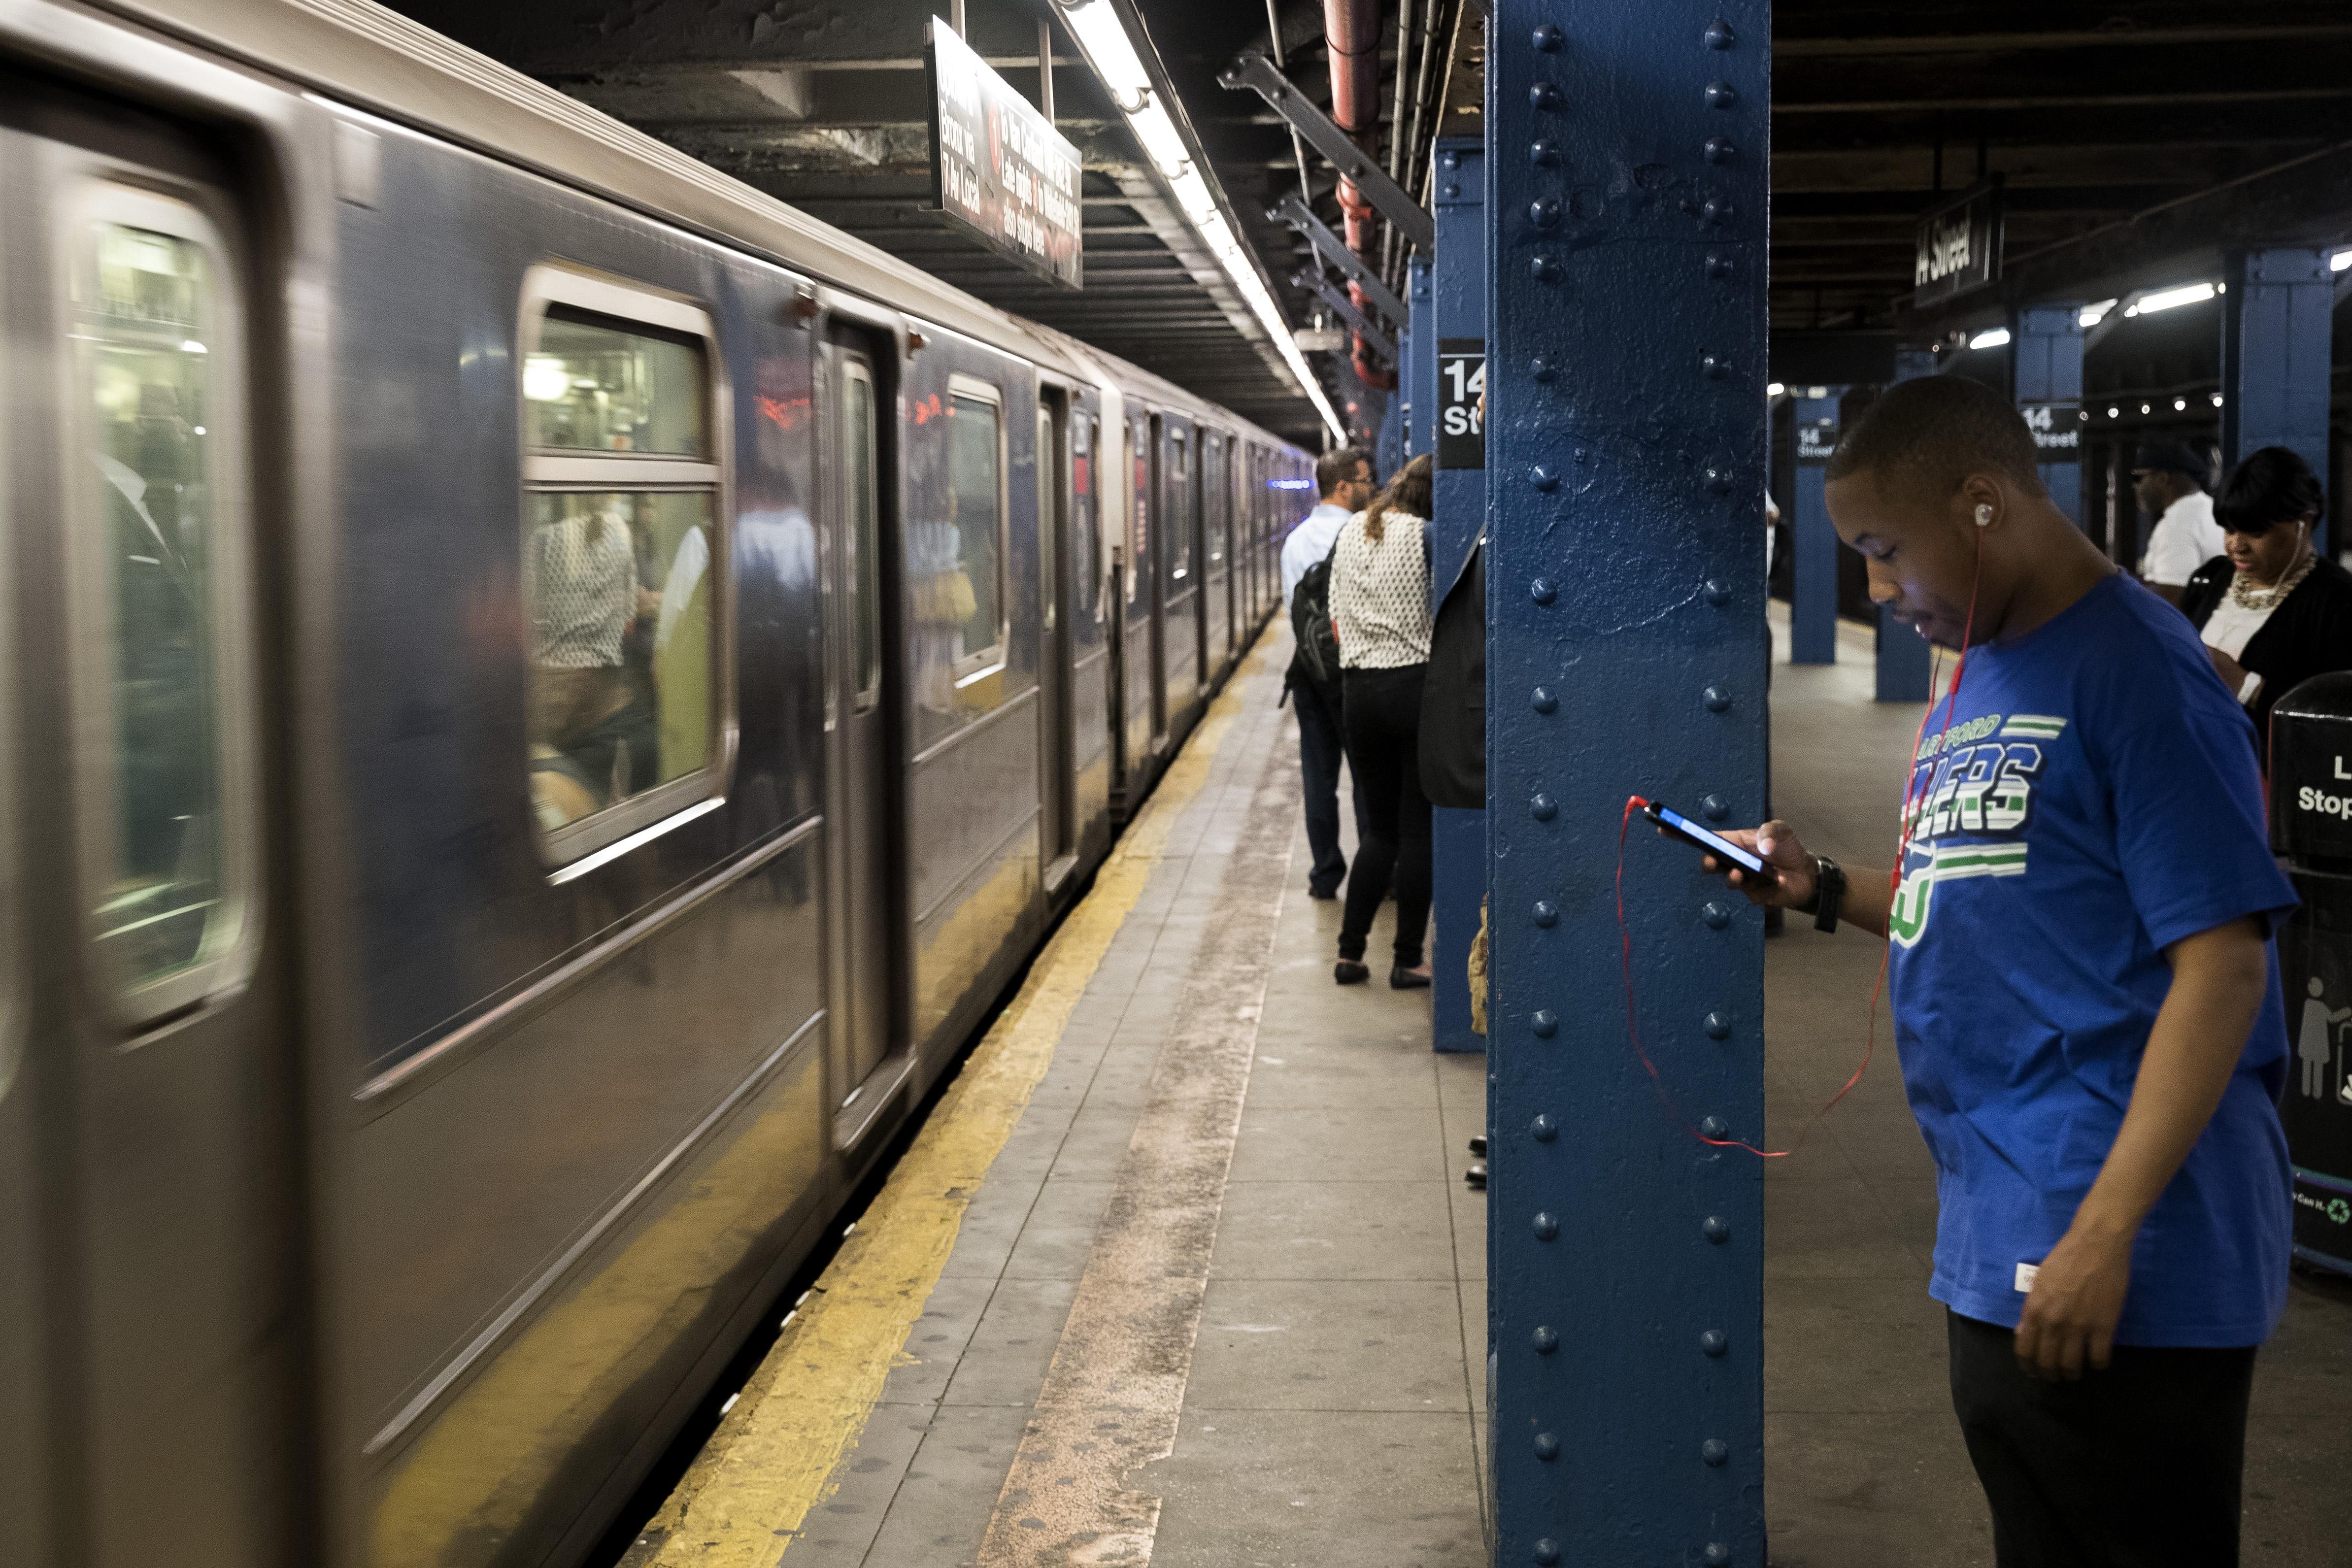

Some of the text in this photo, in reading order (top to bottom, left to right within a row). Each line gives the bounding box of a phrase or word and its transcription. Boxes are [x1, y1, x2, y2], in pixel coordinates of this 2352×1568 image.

[941, 99, 975, 166] Bronx via
[1000, 101, 1009, 145] To
[1008, 109, 1021, 155] Van
[943, 151, 980, 216] 7 Av Local
[1001, 148, 1015, 194] Late
[1016, 162, 1033, 209] nights
[1038, 179, 1044, 216] to
[1004, 196, 1016, 239] also
[1017, 208, 1033, 254] stops
[1444, 360, 1485, 402] 14
[1798, 428, 1820, 445] 14
[2021, 406, 2053, 431] 14
[2033, 430, 2079, 448] treet
